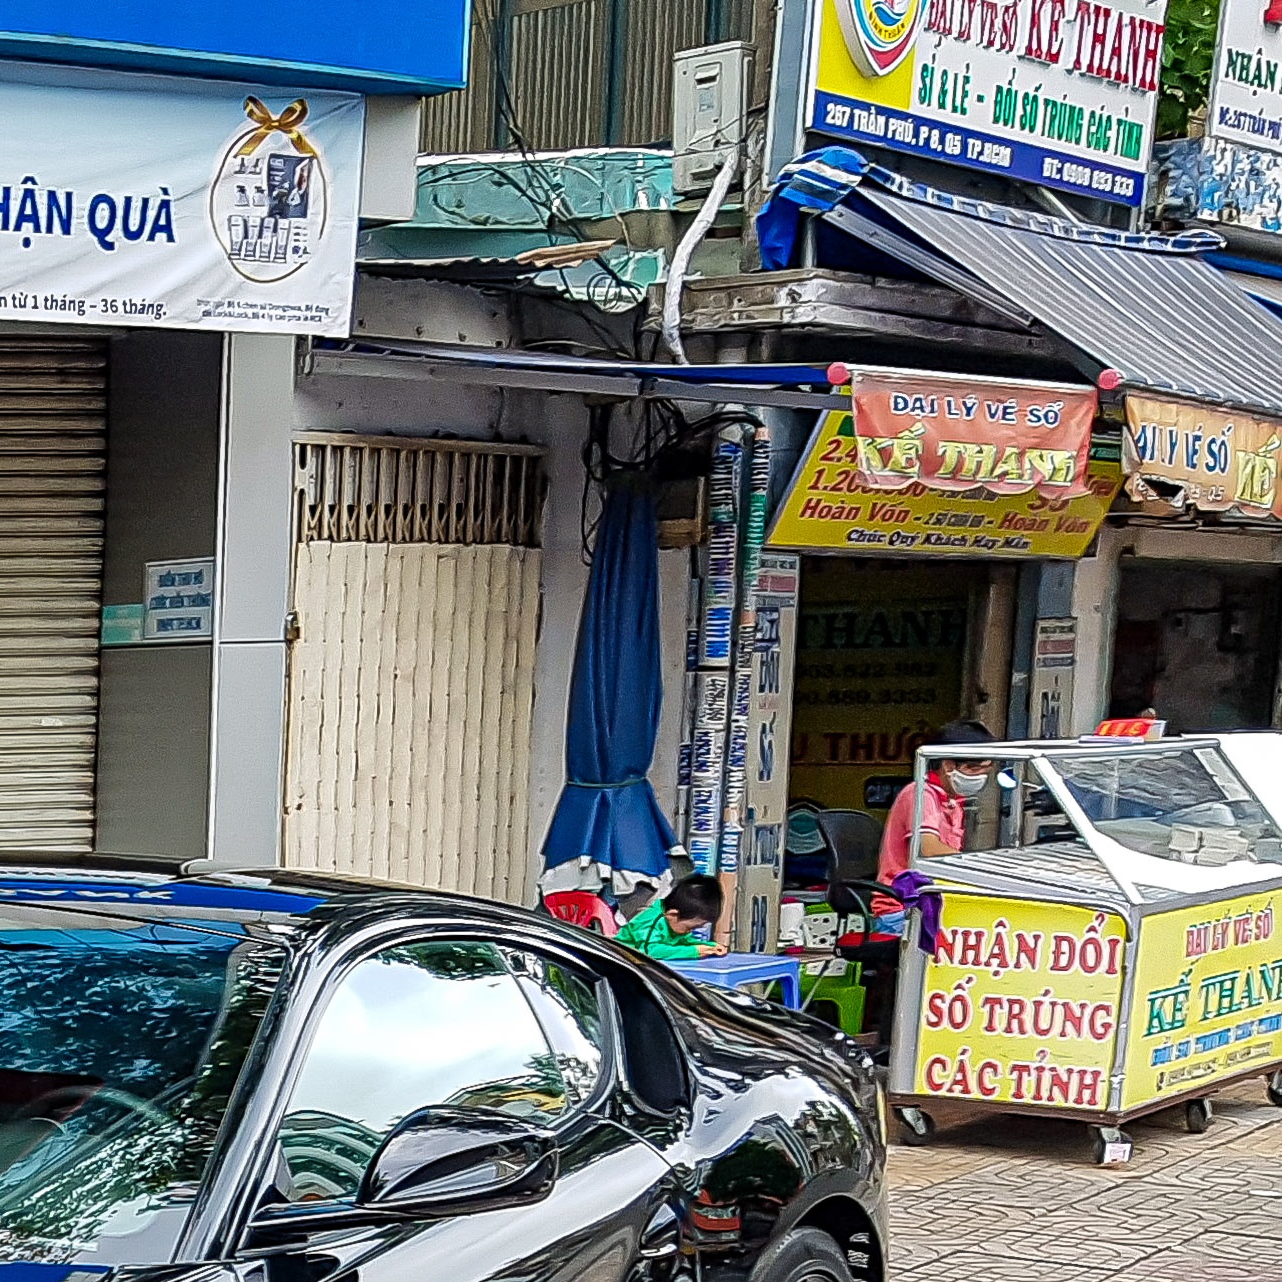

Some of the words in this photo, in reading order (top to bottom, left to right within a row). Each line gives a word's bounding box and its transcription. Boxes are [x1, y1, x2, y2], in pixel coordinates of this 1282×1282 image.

[1224, 47, 1279, 96] NHẬN
[1020, 83, 1043, 134] SỐ
[87, 186, 176, 251] QUÀ
[12, 292, 28, 310] từ
[31, 295, 40, 310] 1
[43, 294, 85, 316] tháng
[100, 298, 119, 314] 36
[122, 297, 167, 320] tháng.
[892, 392, 938, 418] ĐẠI
[946, 394, 979, 421] LÝ
[985, 398, 1017, 424] VÉ
[1027, 400, 1065, 428] SỐ
[856, 421, 926, 480] KẾ
[1204, 424, 1234, 475] SỐ
[799, 497, 862, 521] Hoàn
[868, 500, 912, 524] Vốn
[934, 919, 1042, 977] NHẬN
[1050, 912, 1121, 975] ĐỔI
[925, 975, 975, 1029] SỐ
[982, 988, 1114, 1040] TRÚNG
[925, 1047, 998, 1097] CÁC
[1009, 1048, 1103, 1106] TỈNH
